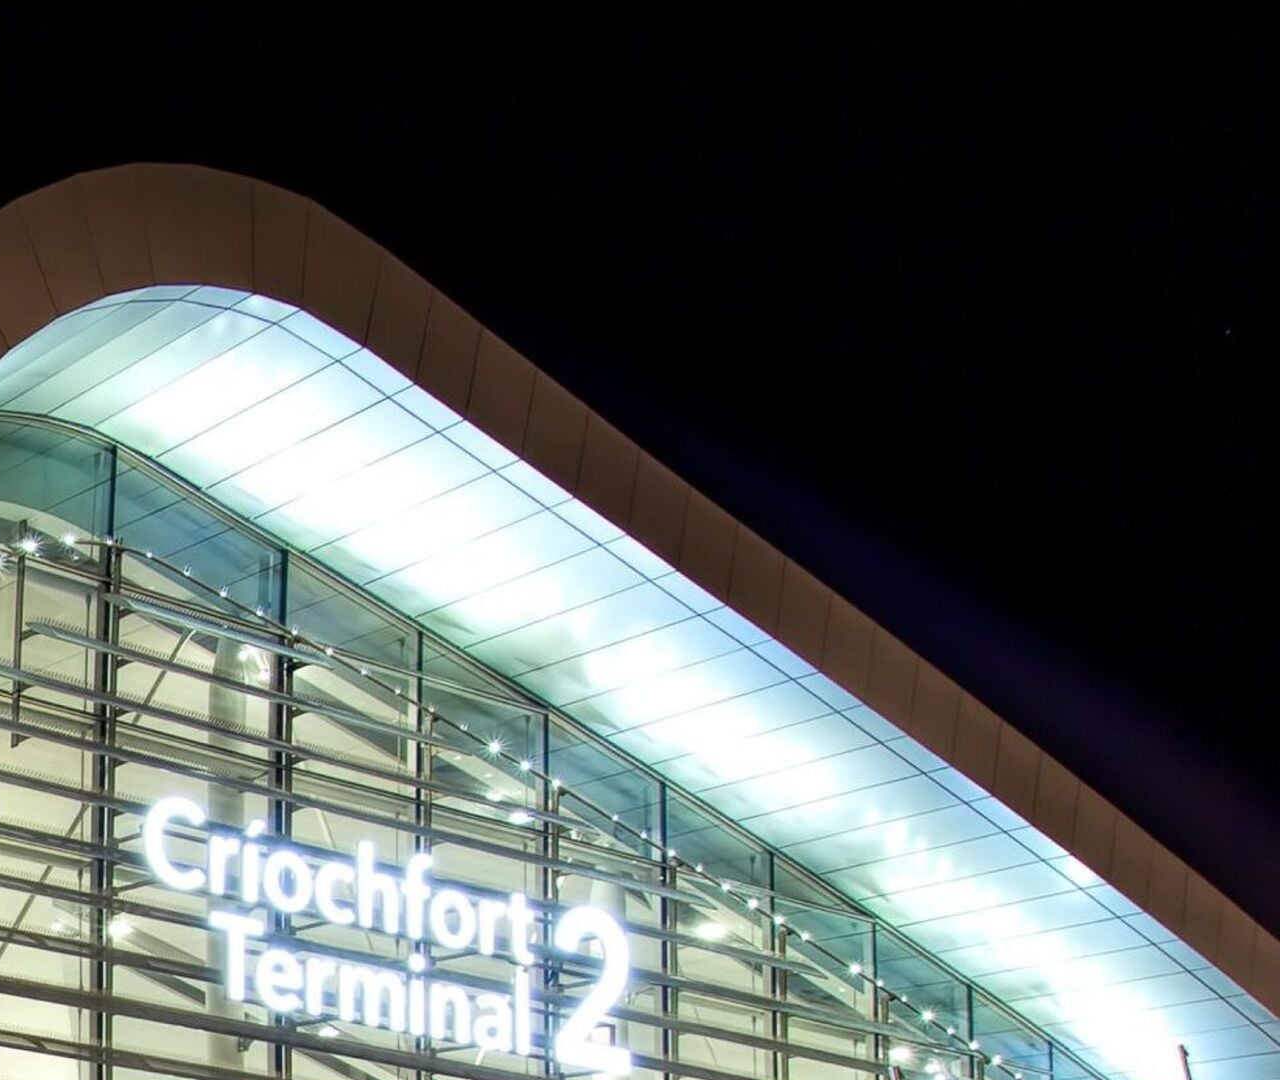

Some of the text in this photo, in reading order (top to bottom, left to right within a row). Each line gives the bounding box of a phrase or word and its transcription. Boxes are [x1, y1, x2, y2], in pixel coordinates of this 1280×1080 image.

[144, 797, 536, 965] Críochfort
[210, 905, 633, 1074] Terminal 2
